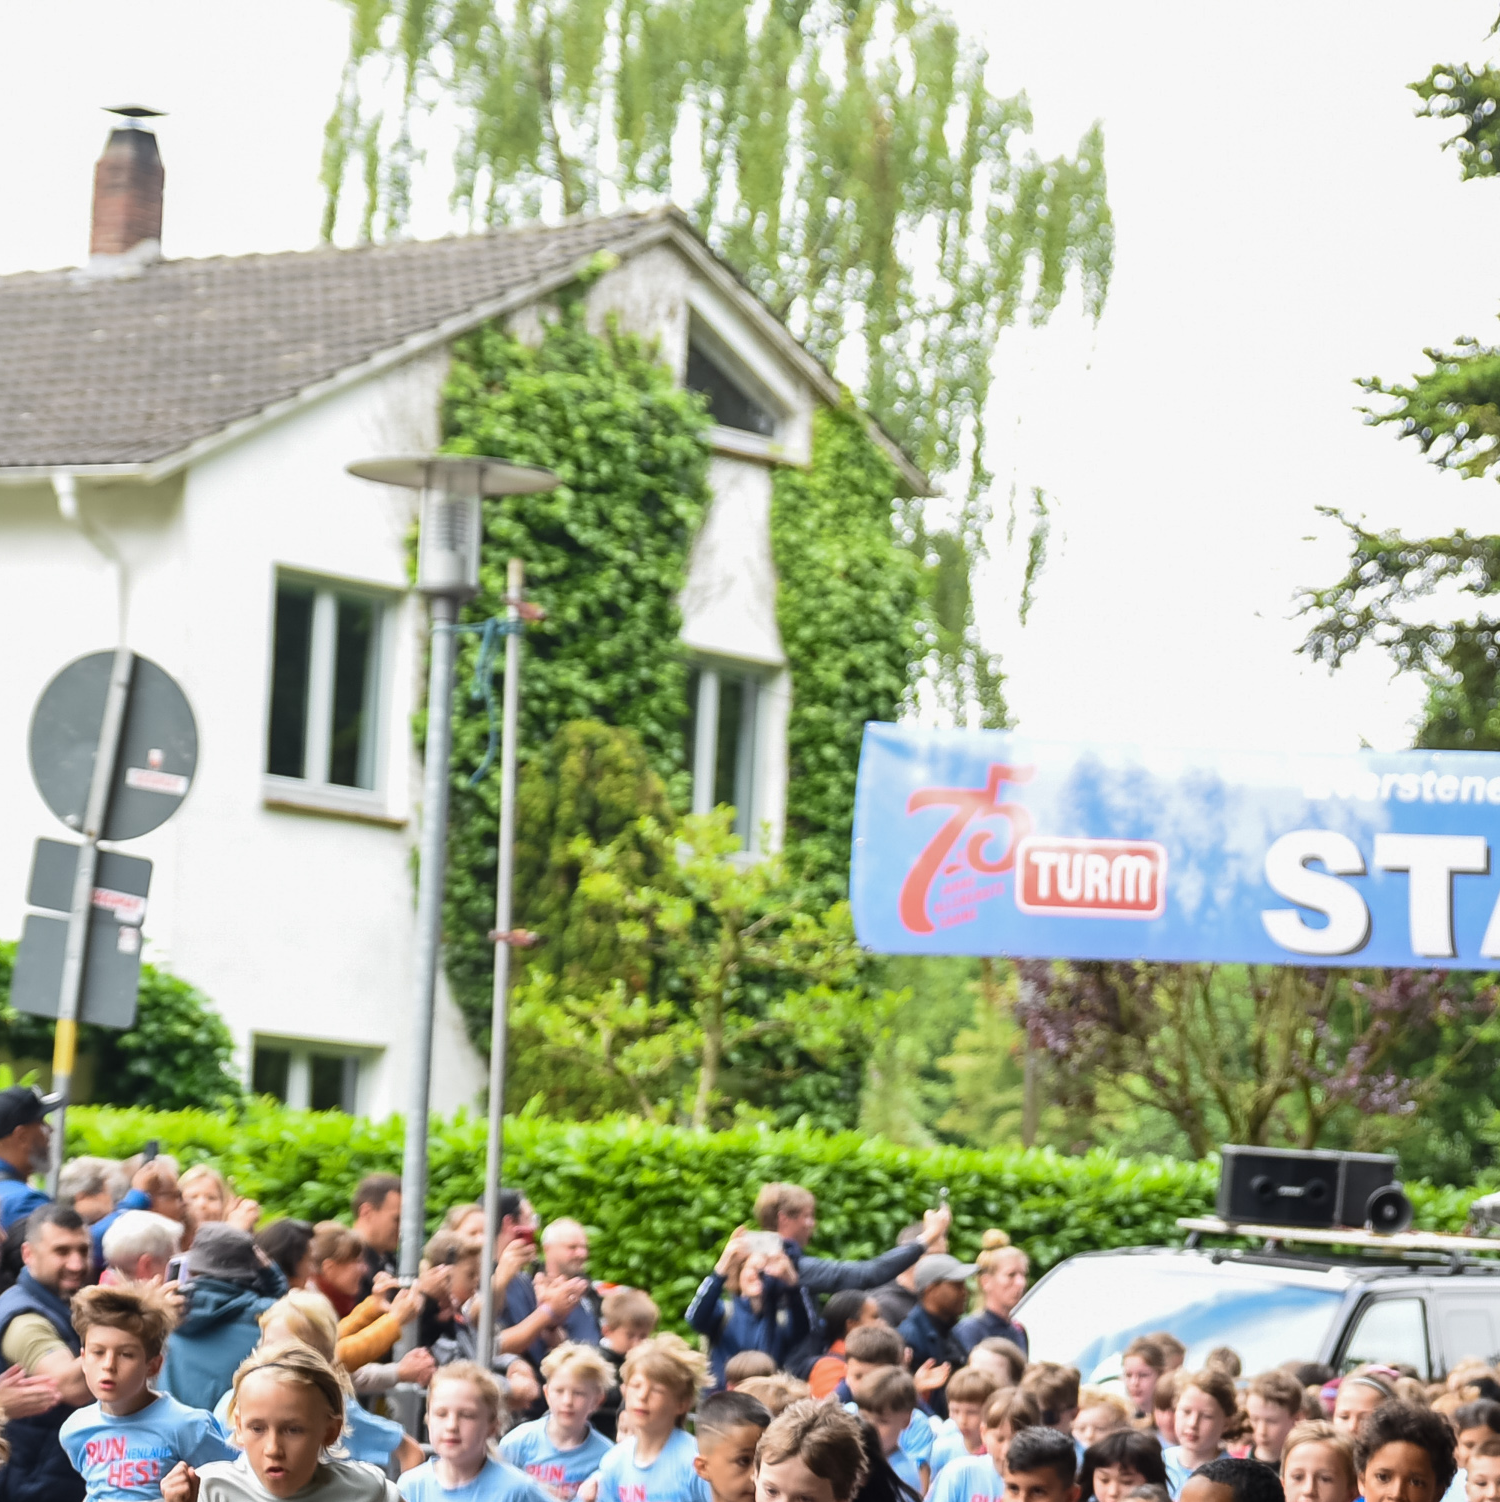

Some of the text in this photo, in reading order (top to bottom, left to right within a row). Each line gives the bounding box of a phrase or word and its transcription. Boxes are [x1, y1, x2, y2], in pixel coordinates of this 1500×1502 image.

[1029, 851, 1153, 904] TURM
[86, 1436, 126, 1466] RUN
[107, 1459, 159, 1488] HES!
